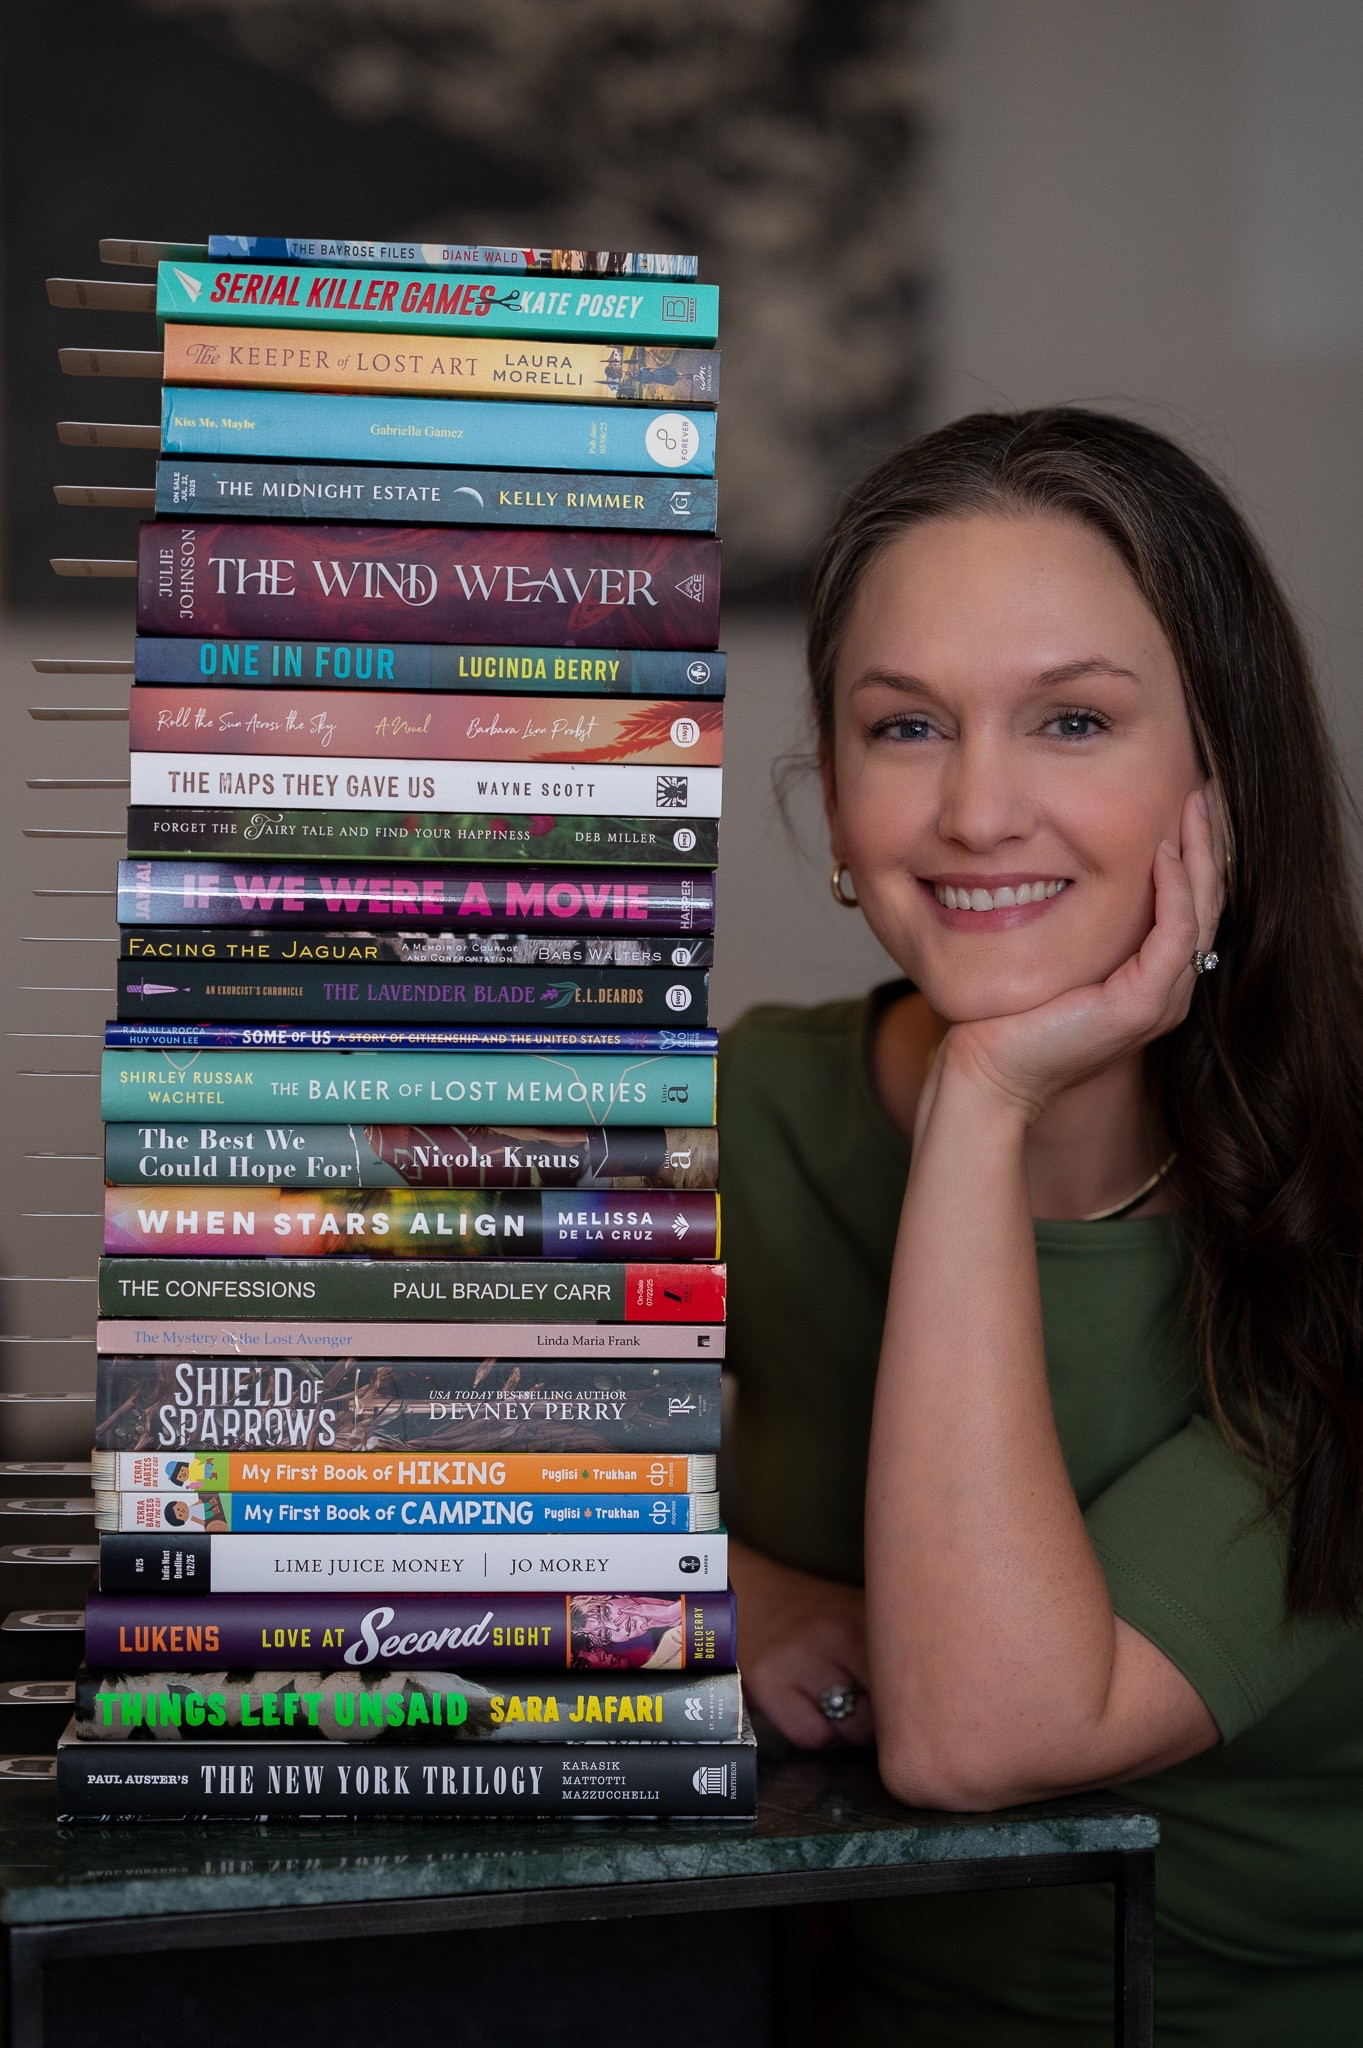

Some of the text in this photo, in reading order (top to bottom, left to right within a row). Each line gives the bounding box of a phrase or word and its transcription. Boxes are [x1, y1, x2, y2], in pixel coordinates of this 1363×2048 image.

[293, 244, 414, 259] THE BAYROSE FILES
[442, 249, 517, 263] DIANE WALD
[209, 272, 496, 317] SERIAL KILLER GAMES
[519, 291, 643, 319] KATE POSEY
[186, 343, 478, 376] The KEEPER of LOST ART
[505, 354, 572, 369] LAURA
[493, 370, 583, 385] MORELLI
[174, 417, 196, 427] Kiss
[221, 419, 255, 429] Maybe
[369, 423, 463, 438] Gabriella Gamez
[173, 491, 179, 503] ON
[216, 481, 441, 502] THE MIDNIGHT ESTATE
[499, 491, 645, 509] KELLY RIMMER
[159, 549, 173, 597] JULIE
[180, 529, 195, 619] JOHNSON
[208, 558, 658, 606] THE WIND WEAVER
[693, 574, 701, 602] ACE
[200, 643, 394, 679] ONE IN FOUR
[459, 656, 619, 681] LUCINDA BERRY
[168, 771, 435, 799] THE MAPS THEY GAVE US
[477, 781, 594, 797] WAYNE SCOTT
[575, 833, 656, 843] DEB MILLER
[183, 875, 648, 919] IF WE WERE A MOVIE
[206, 986, 216, 995] AN
[262, 987, 303, 996] CHRONICLE
[323, 984, 535, 1003] THE LAVENDER BLADE
[242, 1030, 331, 1045] SOME OF US
[120, 1072, 253, 1084] SHIRLEY RUSSAK
[149, 1091, 224, 1104] WACHTEL
[271, 1080, 647, 1103] THE BAKER OF LOST MEMORIES
[138, 1129, 305, 1150] The Best We
[412, 1146, 579, 1168] Nicola Kraus
[138, 1156, 351, 1182] Could Hope For
[137, 1210, 525, 1238] WHEN STARS ALIGN
[558, 1212, 654, 1225] MELISSA
[559, 1230, 652, 1240] DE LA CRUZ
[119, 1280, 315, 1298] THE CONFESSIONS
[393, 1283, 611, 1300] PAUL BRADLEY CARR
[537, 1336, 641, 1346] Linda Maria Frank
[174, 1363, 323, 1407] SHIELD OF
[429, 1391, 627, 1400] USA TODAY BESTSELLING AUTHOR
[429, 1403, 627, 1420] DEVNEY PERRY
[158, 1405, 336, 1446] SPARROWS
[134, 1459, 142, 1484] TERRA
[143, 1458, 151, 1487] BABIES
[242, 1461, 506, 1486] My First Book of HIKING
[542, 1468, 637, 1482] Puglisi Trukhan
[186, 1555, 194, 1576] 6/2/25
[274, 1559, 465, 1575] LIME JUICE MONEY
[510, 1559, 609, 1575] JO MOREY
[120, 1626, 219, 1652] LUKENS
[262, 1606, 551, 1666] LOVE AT Second SIGHT
[706, 1630, 714, 1659] BOOKS
[96, 1692, 468, 1728] THINGS LEFT UNSAID
[490, 1696, 663, 1723] SARA JAFARI
[562, 1761, 620, 1771] KARASIK
[86, 1774, 188, 1785] PAUL AUSTER'S
[201, 1765, 543, 1795] THE NEW YORK TRILOGY
[562, 1777, 625, 1785] MATTOTTI
[562, 1791, 659, 1800] MAZZUCCHELLI
